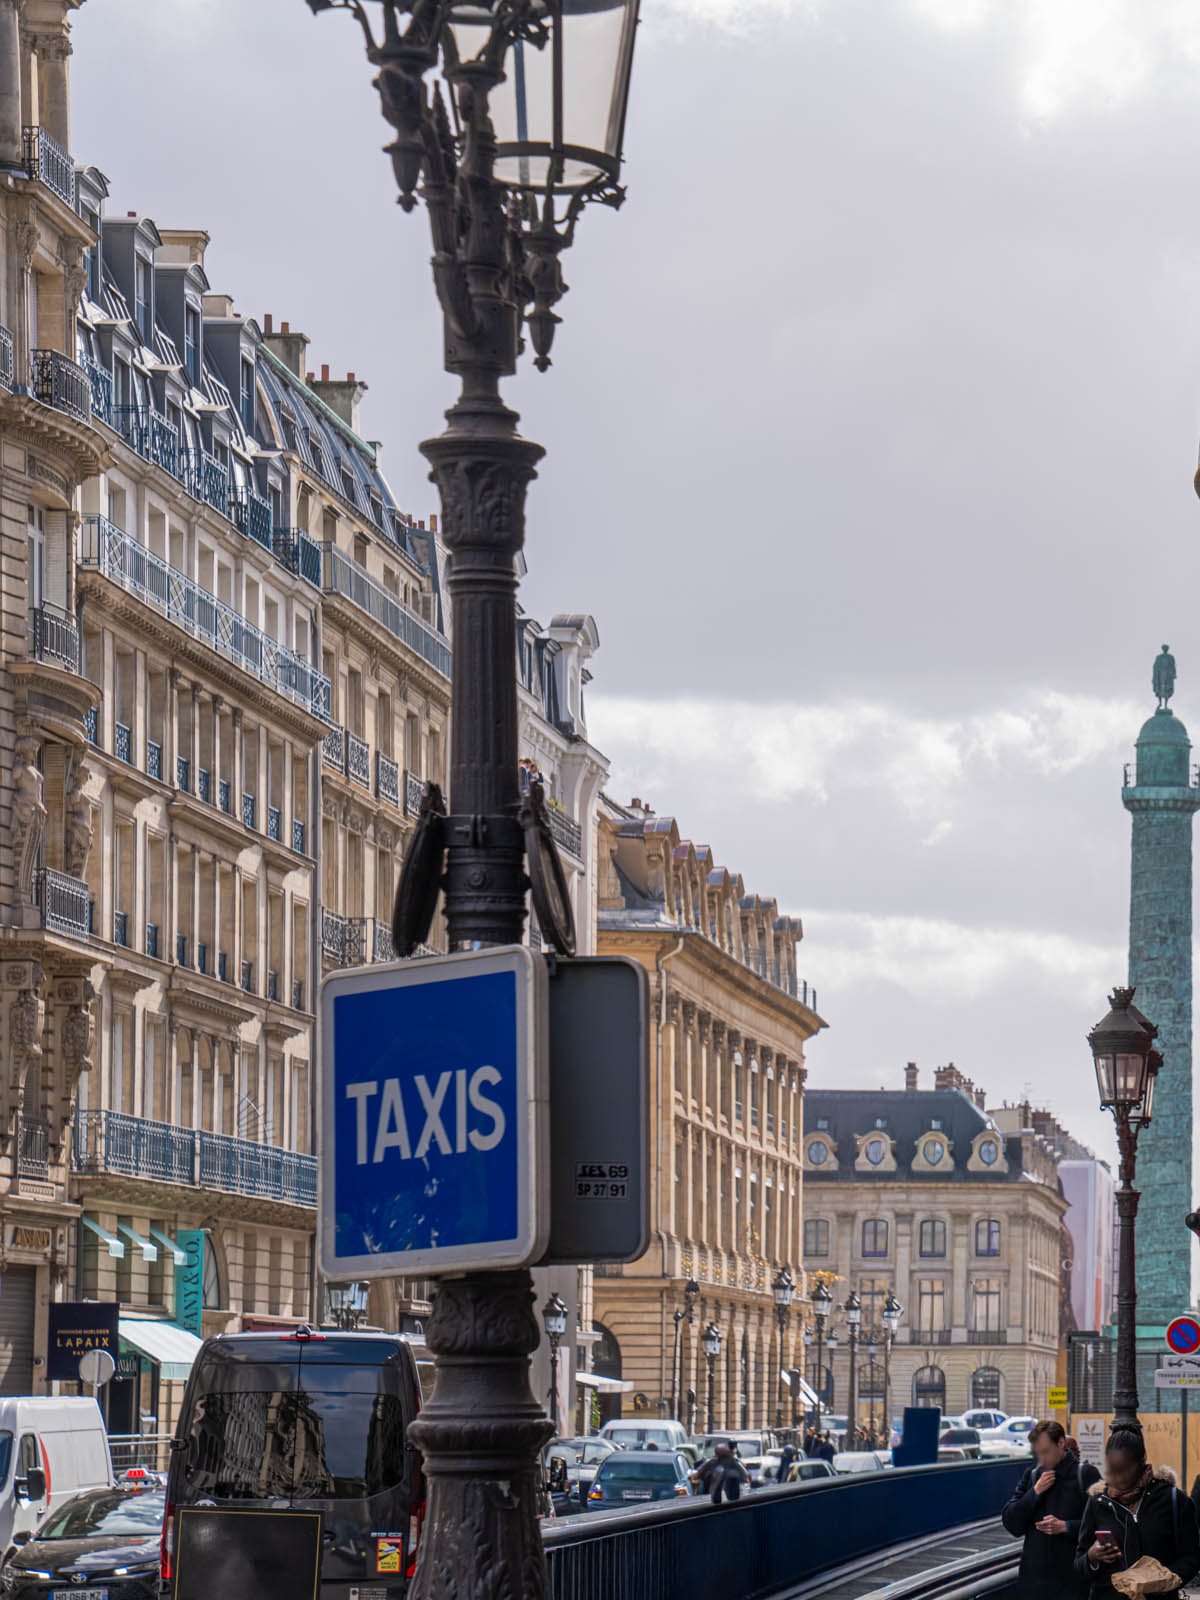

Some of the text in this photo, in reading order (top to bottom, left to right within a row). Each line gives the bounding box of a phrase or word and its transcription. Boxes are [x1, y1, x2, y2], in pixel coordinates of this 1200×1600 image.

[346, 1065, 506, 1165] TAXIS
[609, 1165, 628, 1178] 69
[593, 1184, 607, 1196] 37
[610, 1184, 626, 1196] 91
[57, 1336, 109, 1348] LAPAIX
